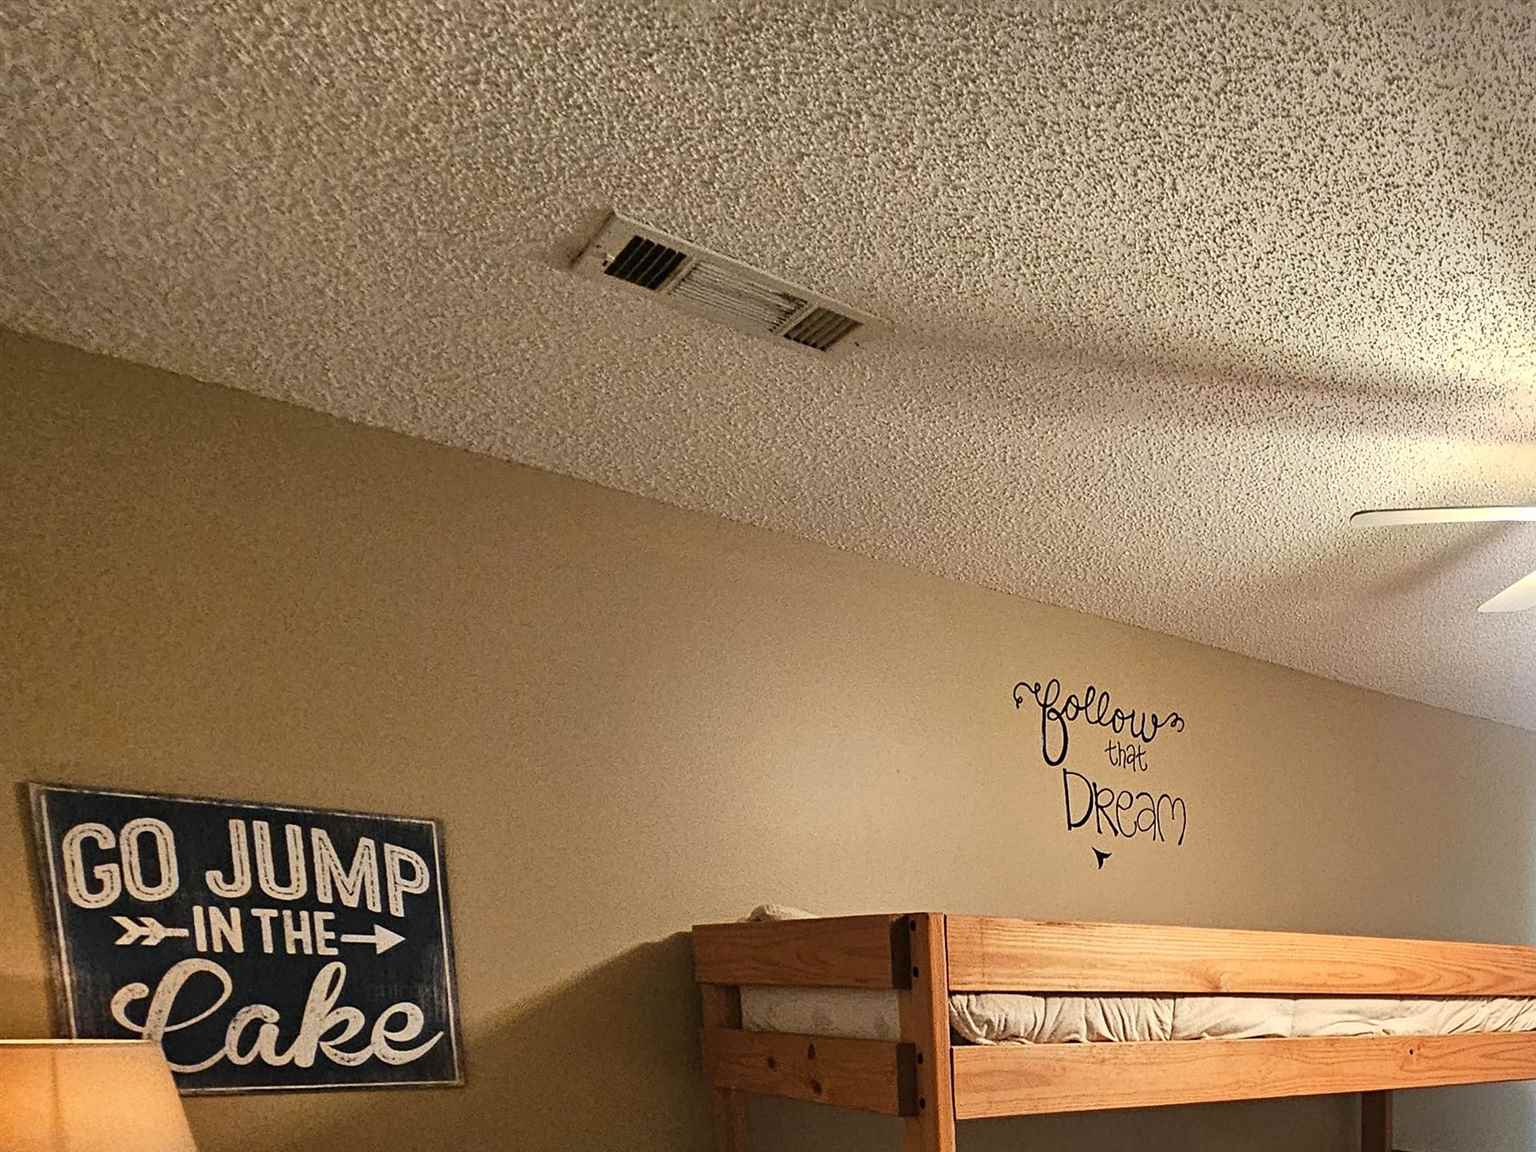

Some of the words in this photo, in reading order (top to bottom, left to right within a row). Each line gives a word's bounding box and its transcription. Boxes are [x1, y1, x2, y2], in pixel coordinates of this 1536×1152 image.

[1104, 740, 1148, 771] that
[62, 818, 180, 909] GO
[205, 818, 430, 917] JUMP
[193, 905, 245, 954] IN
[250, 907, 339, 955] THE
[110, 958, 444, 1073] Lake
